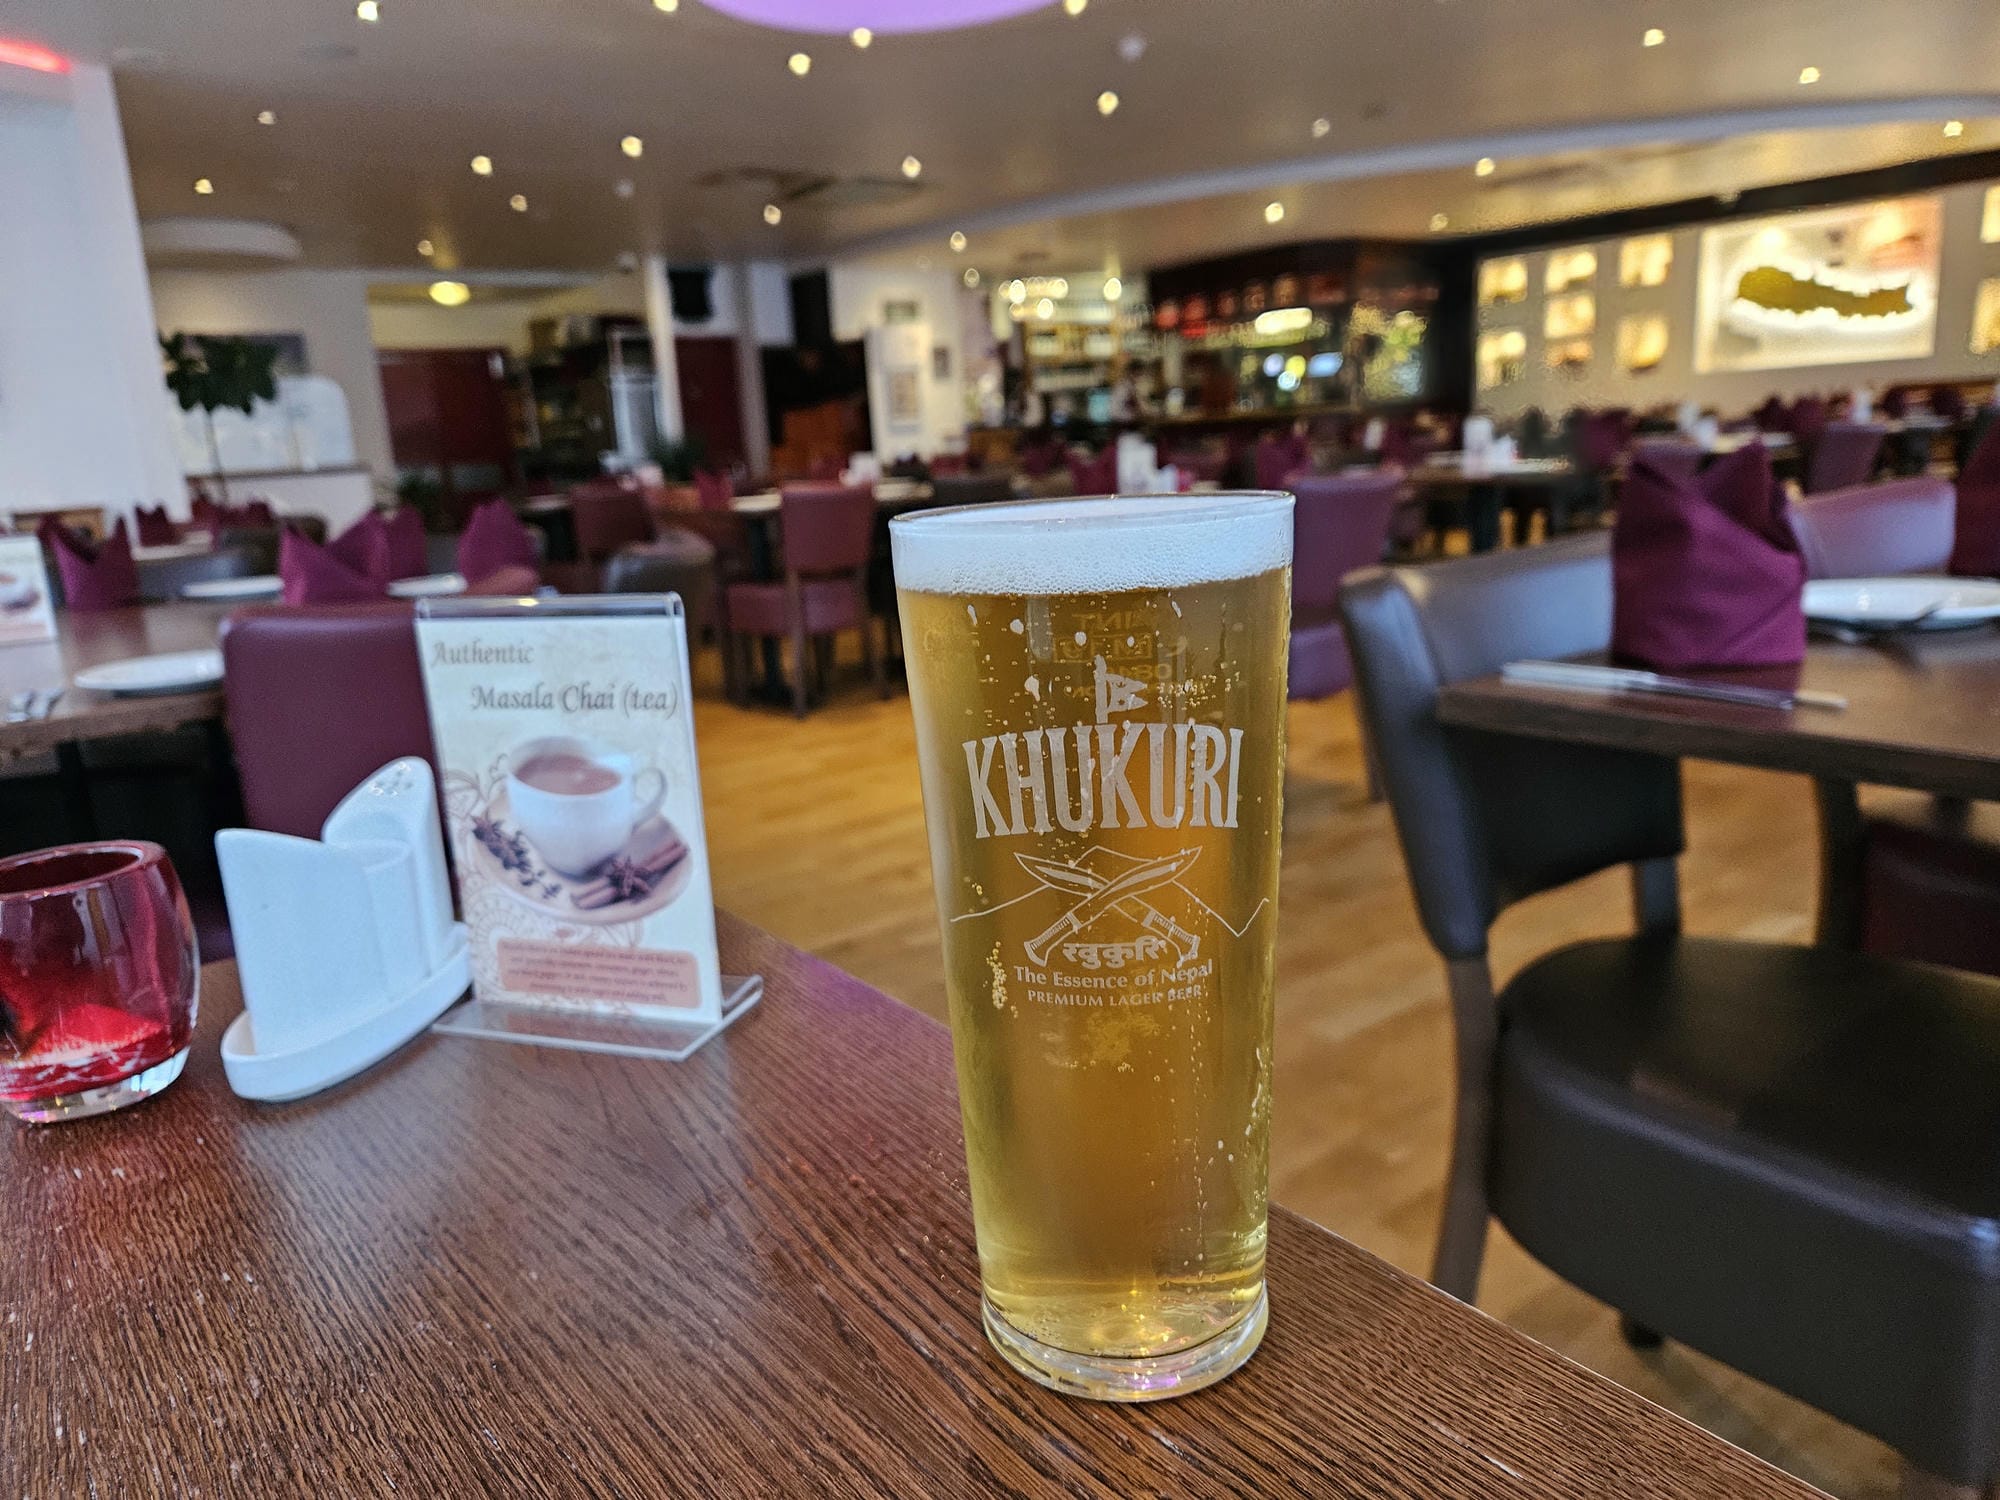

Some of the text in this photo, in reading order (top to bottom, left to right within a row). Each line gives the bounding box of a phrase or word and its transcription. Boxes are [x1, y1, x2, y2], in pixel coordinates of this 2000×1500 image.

[431, 639, 535, 667] Authentic
[471, 679, 679, 719] Masala Chai (tea)
[962, 722, 1244, 839] KHUKURI
[1014, 958, 1213, 989] The Essence of Nepal
[1028, 984, 1201, 1007] PREMIUM LAGER BEER
